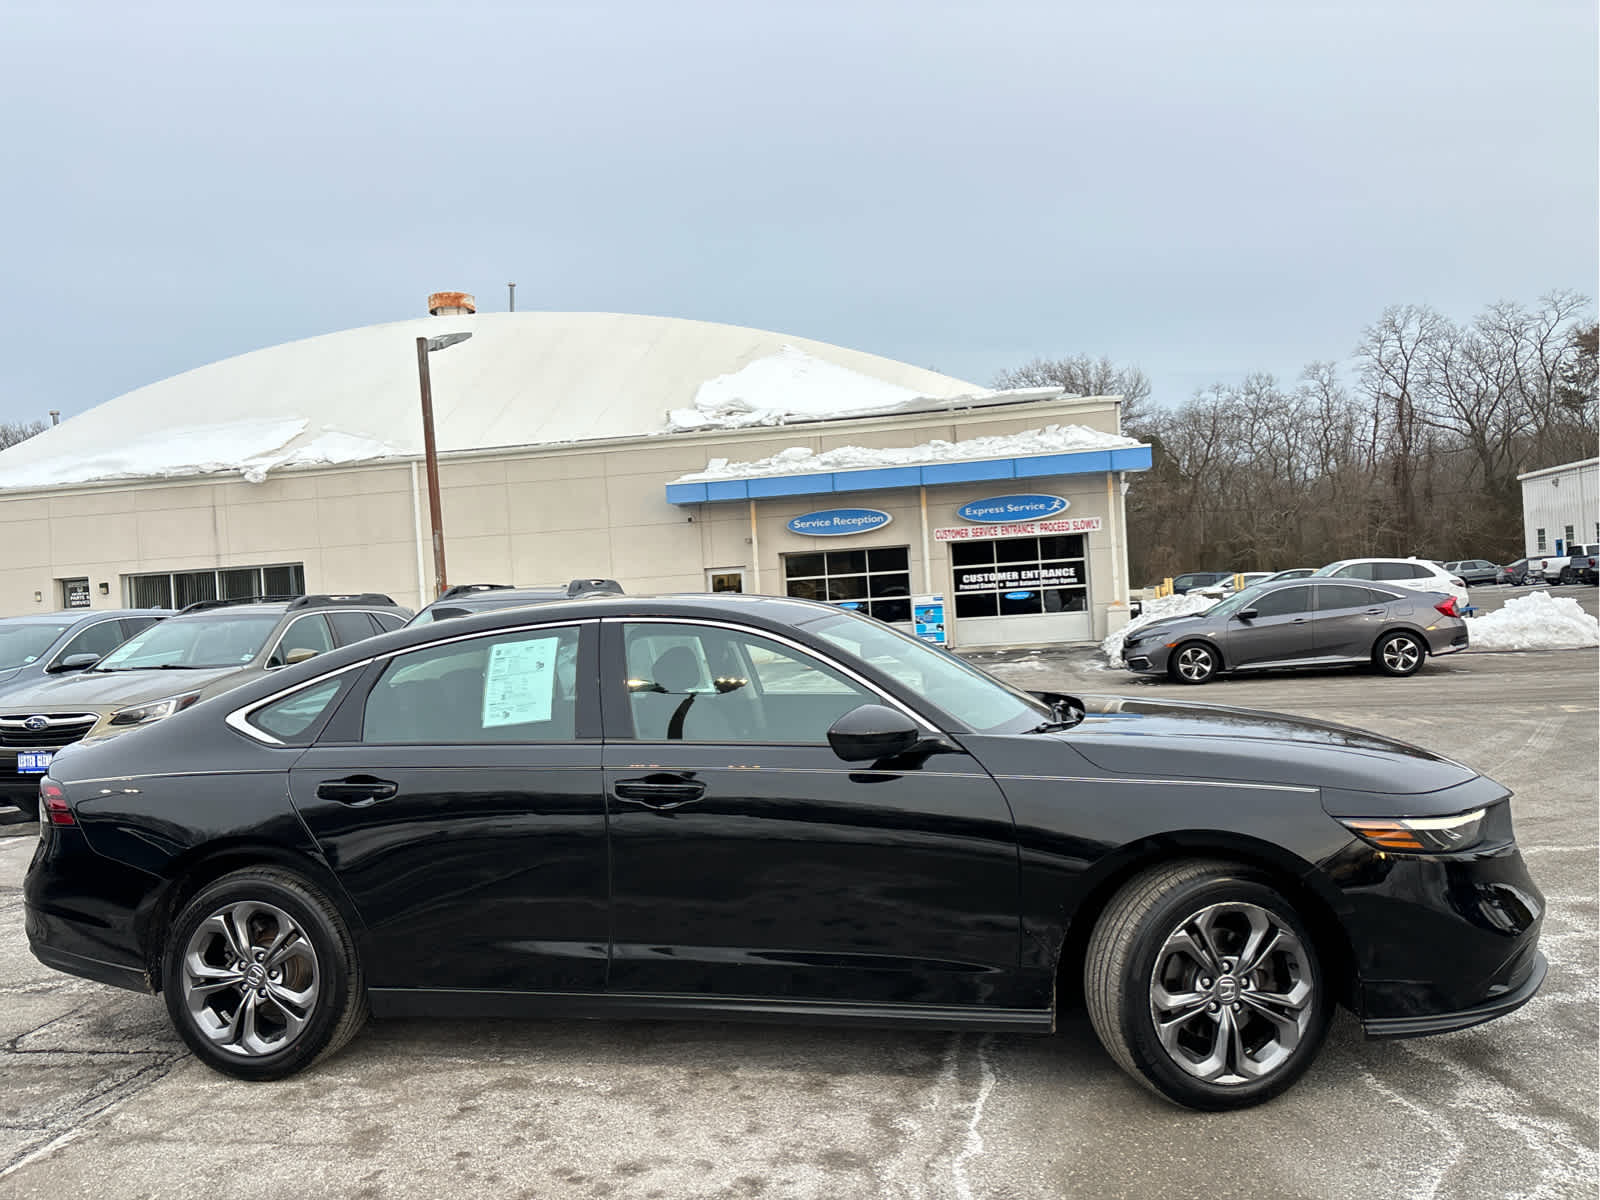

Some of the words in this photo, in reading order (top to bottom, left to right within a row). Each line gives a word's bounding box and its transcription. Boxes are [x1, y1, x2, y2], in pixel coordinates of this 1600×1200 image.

[965, 506, 1004, 517] Express
[1007, 502, 1045, 513] Service
[793, 519, 830, 529] Service
[833, 514, 884, 526] Reception
[935, 528, 969, 540] CUSTOMER
[971, 526, 998, 537] SERVICE
[1001, 523, 1035, 536] ENTRANCE
[1039, 520, 1070, 532] PROCEED
[1072, 518, 1100, 530] SLOWLY
[962, 571, 1019, 583] CUSTOMER
[1021, 567, 1076, 579] ENTRANCE
